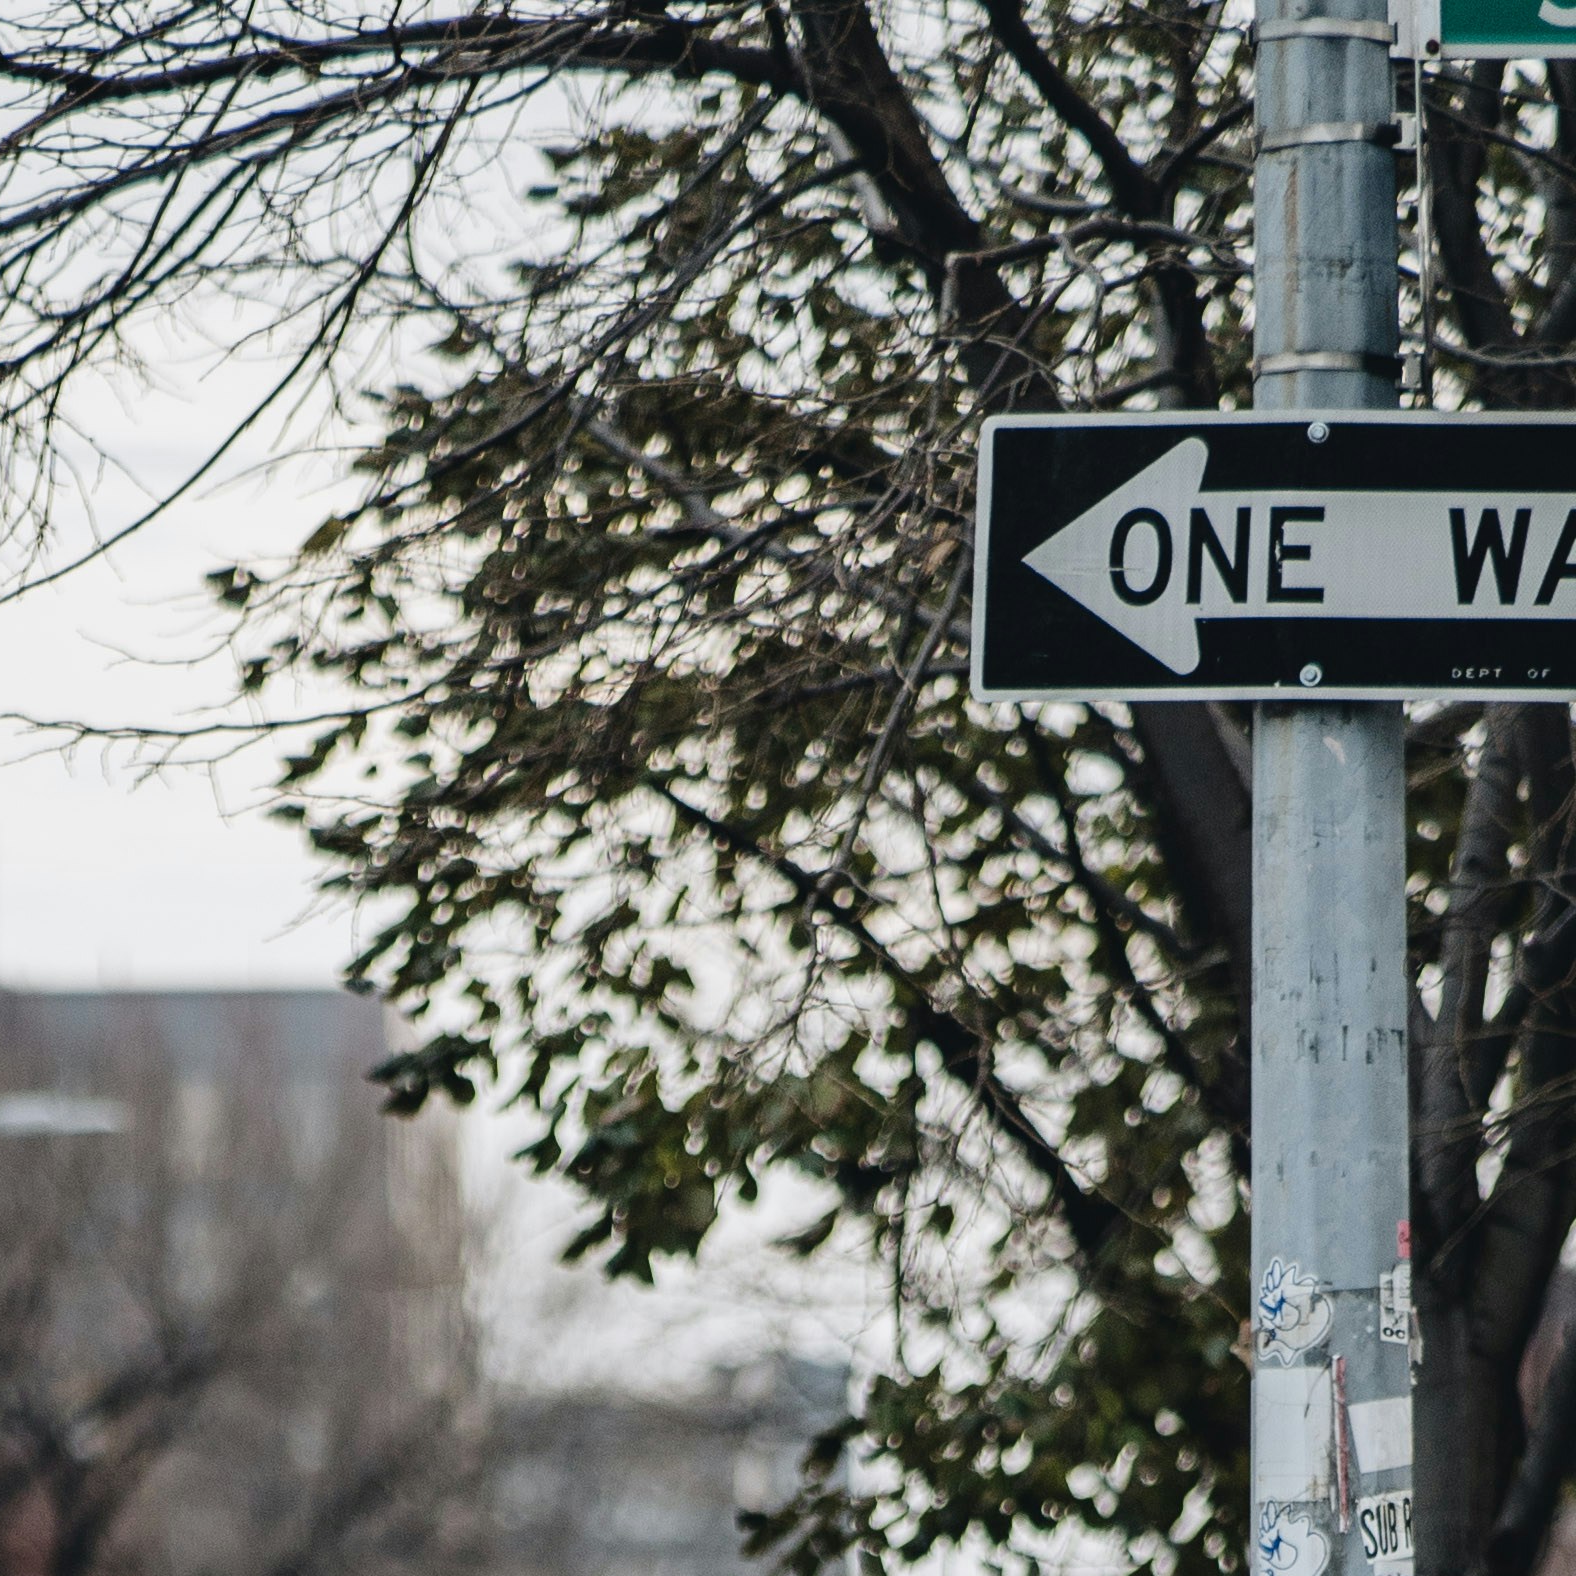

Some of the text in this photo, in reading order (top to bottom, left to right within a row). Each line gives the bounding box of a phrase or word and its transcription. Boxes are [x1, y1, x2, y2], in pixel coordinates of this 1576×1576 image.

[1109, 506, 1325, 606] ONE
[1451, 667, 1551, 679] DEPT OF
[1361, 1502, 1398, 1559] SUB
